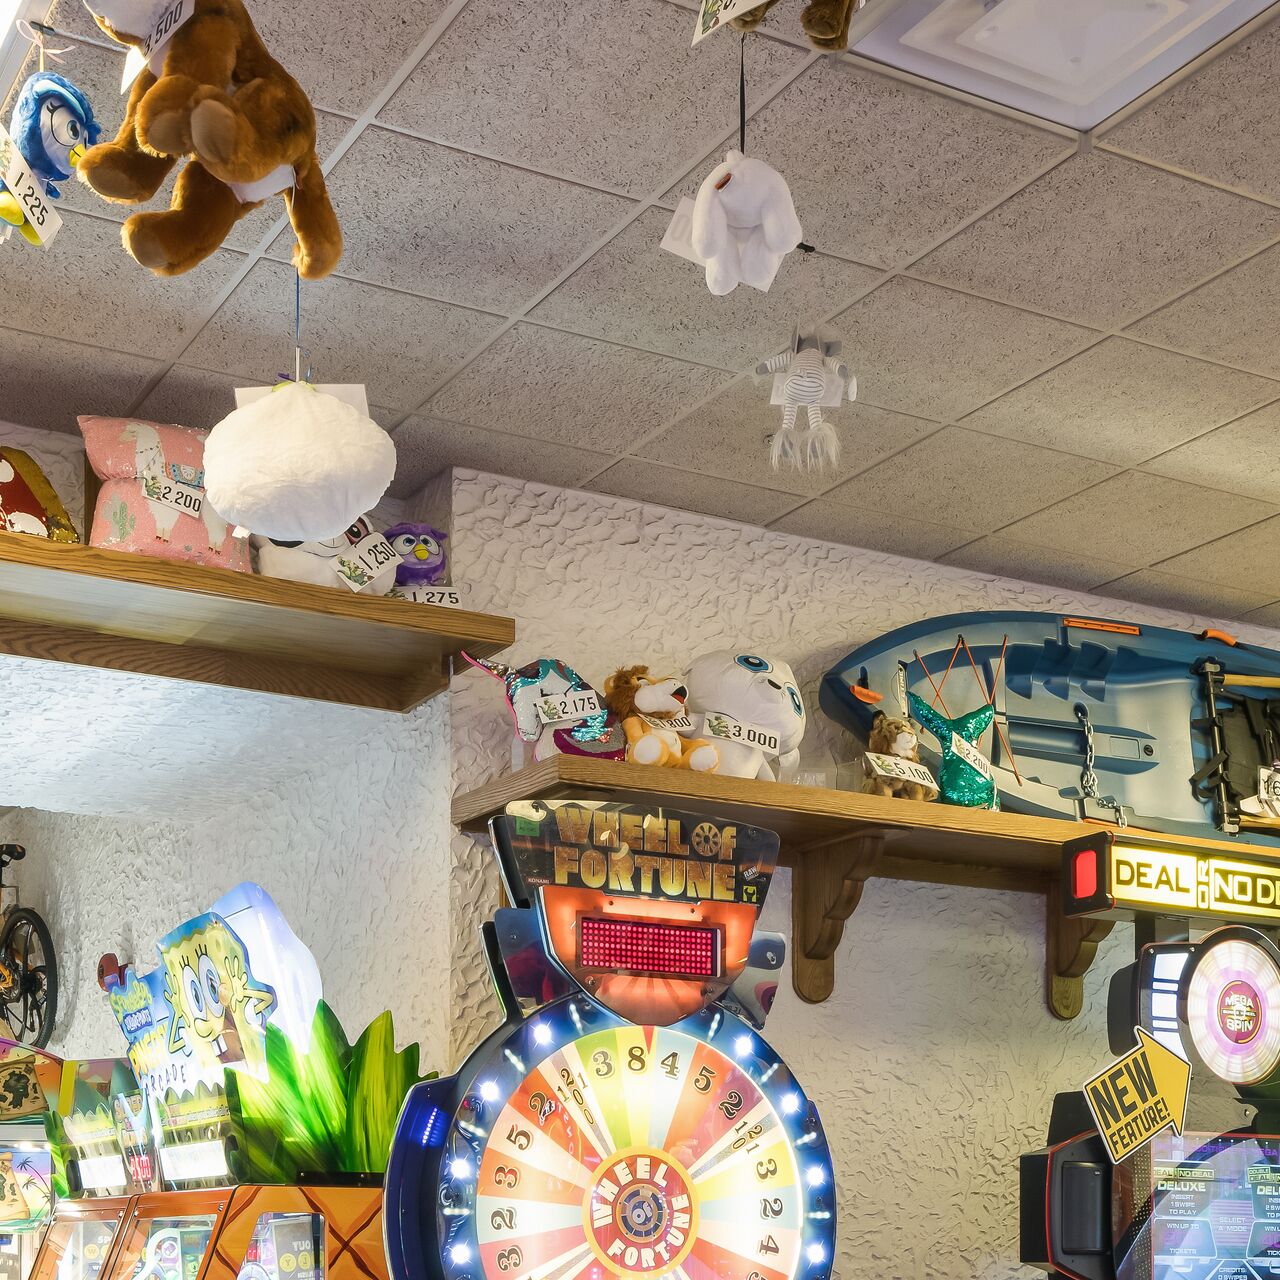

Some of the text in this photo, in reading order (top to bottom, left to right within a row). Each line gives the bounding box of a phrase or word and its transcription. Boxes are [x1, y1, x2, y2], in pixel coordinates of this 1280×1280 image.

[14, 172, 49, 226] 1,225
[161, 485, 202, 513] 2,200
[358, 540, 397, 573] 1,250
[411, 591, 460, 604] 1,275
[559, 695, 597, 716] 2,175
[731, 726, 778, 751] 3,000
[895, 762, 934, 785] 5,100
[554, 806, 690, 856] WHEEL
[553, 846, 737, 901] FORTUNE
[1115, 860, 1190, 894] DEAL
[1197, 860, 1209, 909] OR
[1214, 870, 1253, 900] NO
[1225, 994, 1254, 1009] MEGA
[1226, 1018, 1253, 1033] SPIN
[1091, 1051, 1157, 1129] NEW
[1107, 1096, 1171, 1155] FEATURE!
[1157, 1181, 1207, 1192] DELUXE
[1179, 1169, 1191, 1178] NO
[1192, 1170, 1213, 1179] DEAL
[592, 1157, 670, 1230] WHEEL
